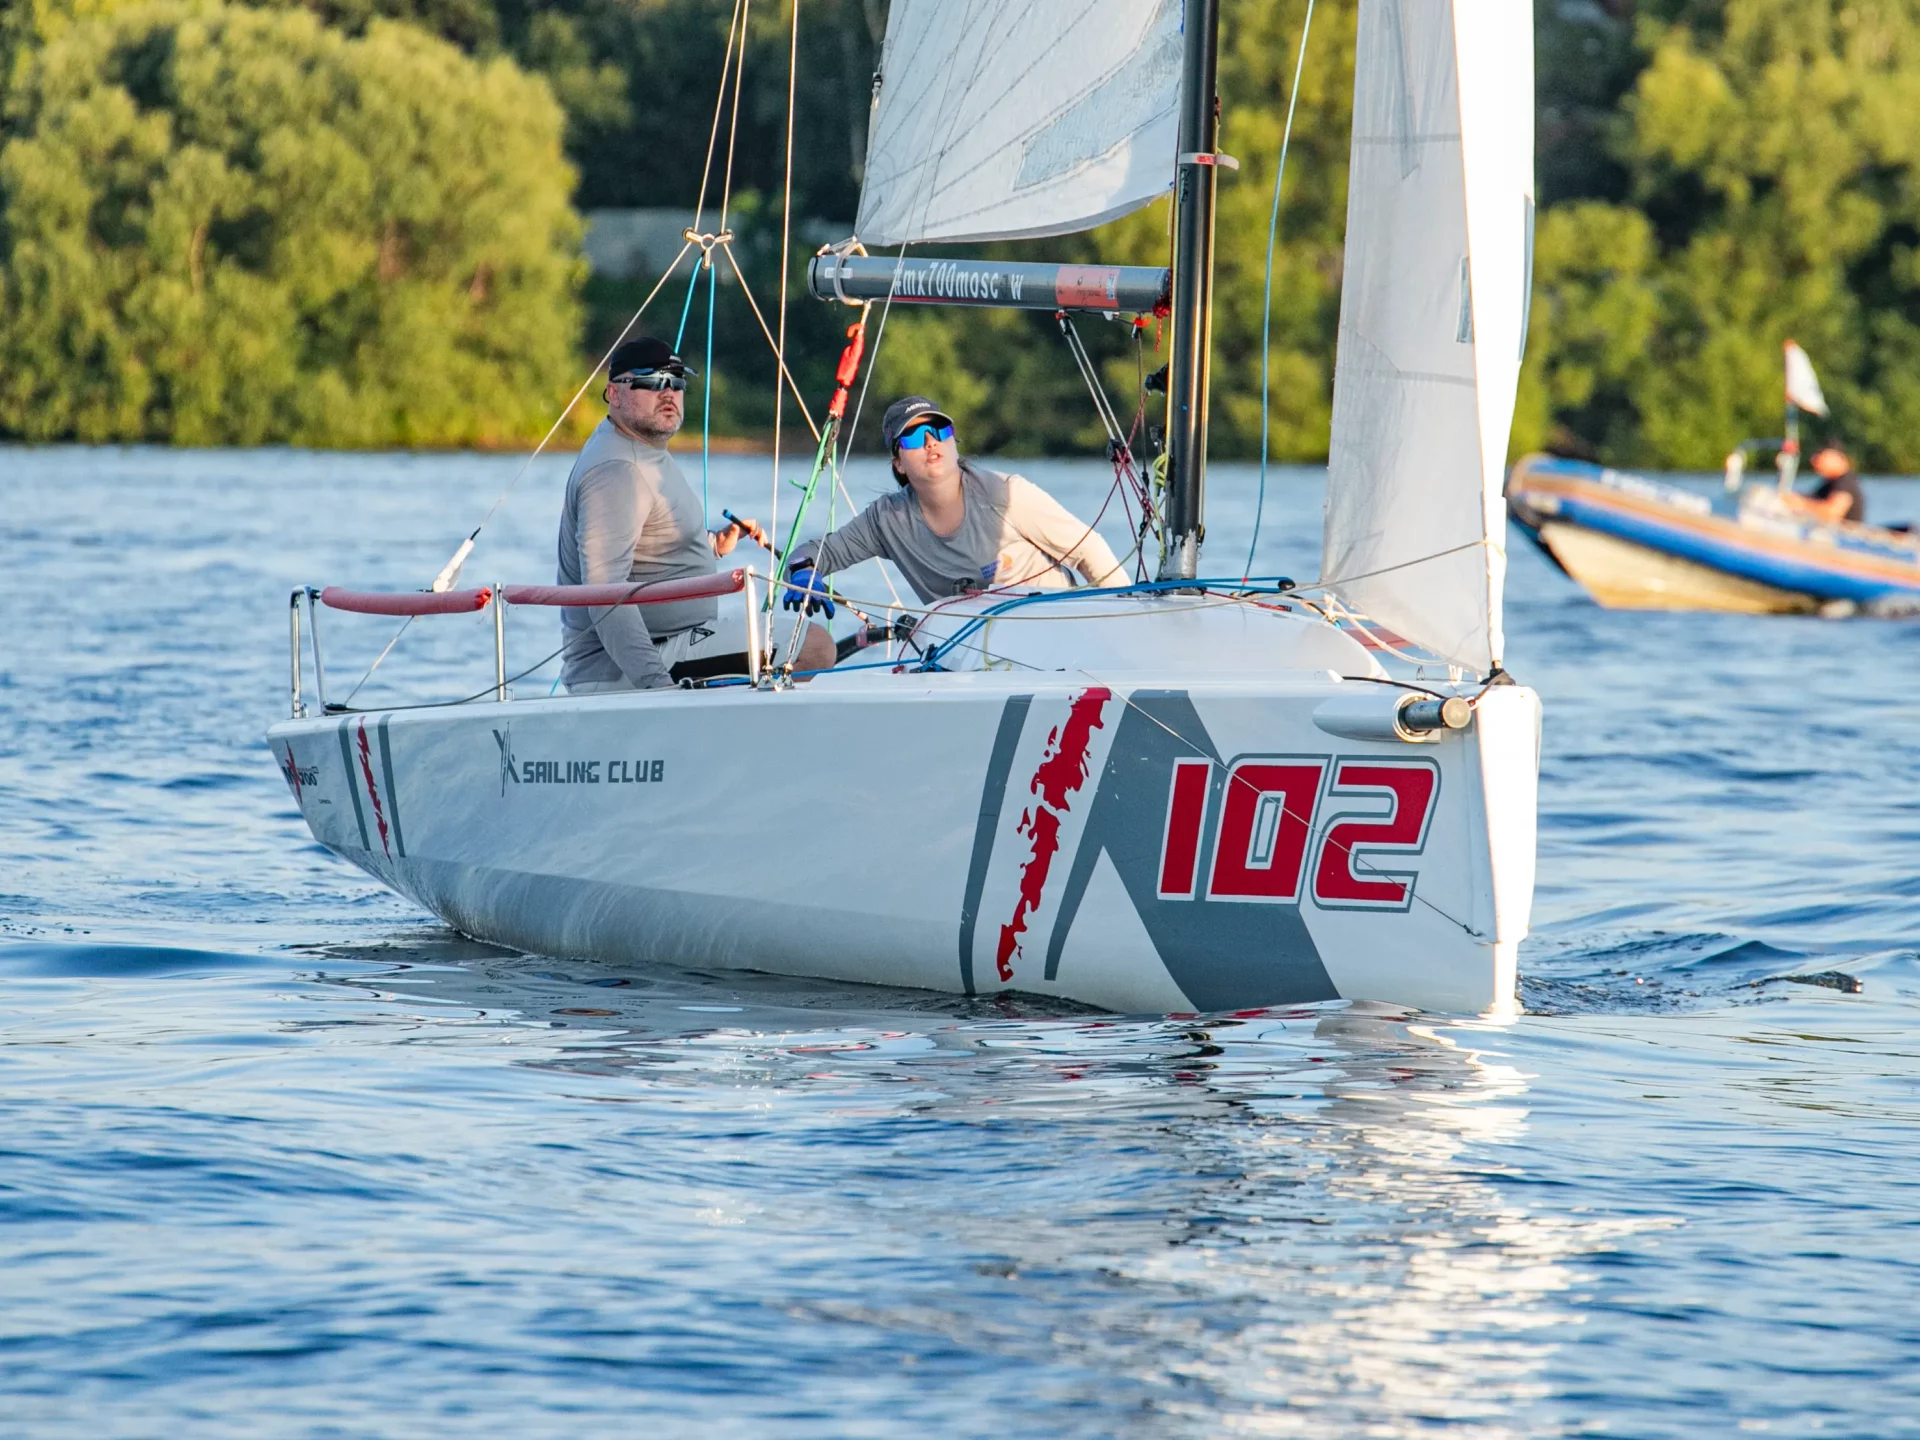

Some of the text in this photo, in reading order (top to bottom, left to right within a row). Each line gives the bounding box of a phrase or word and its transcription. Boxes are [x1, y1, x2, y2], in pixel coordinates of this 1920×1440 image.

[522, 760, 601, 784] SAILING
[607, 759, 665, 783] CLUB
[1157, 752, 1442, 913] 102
